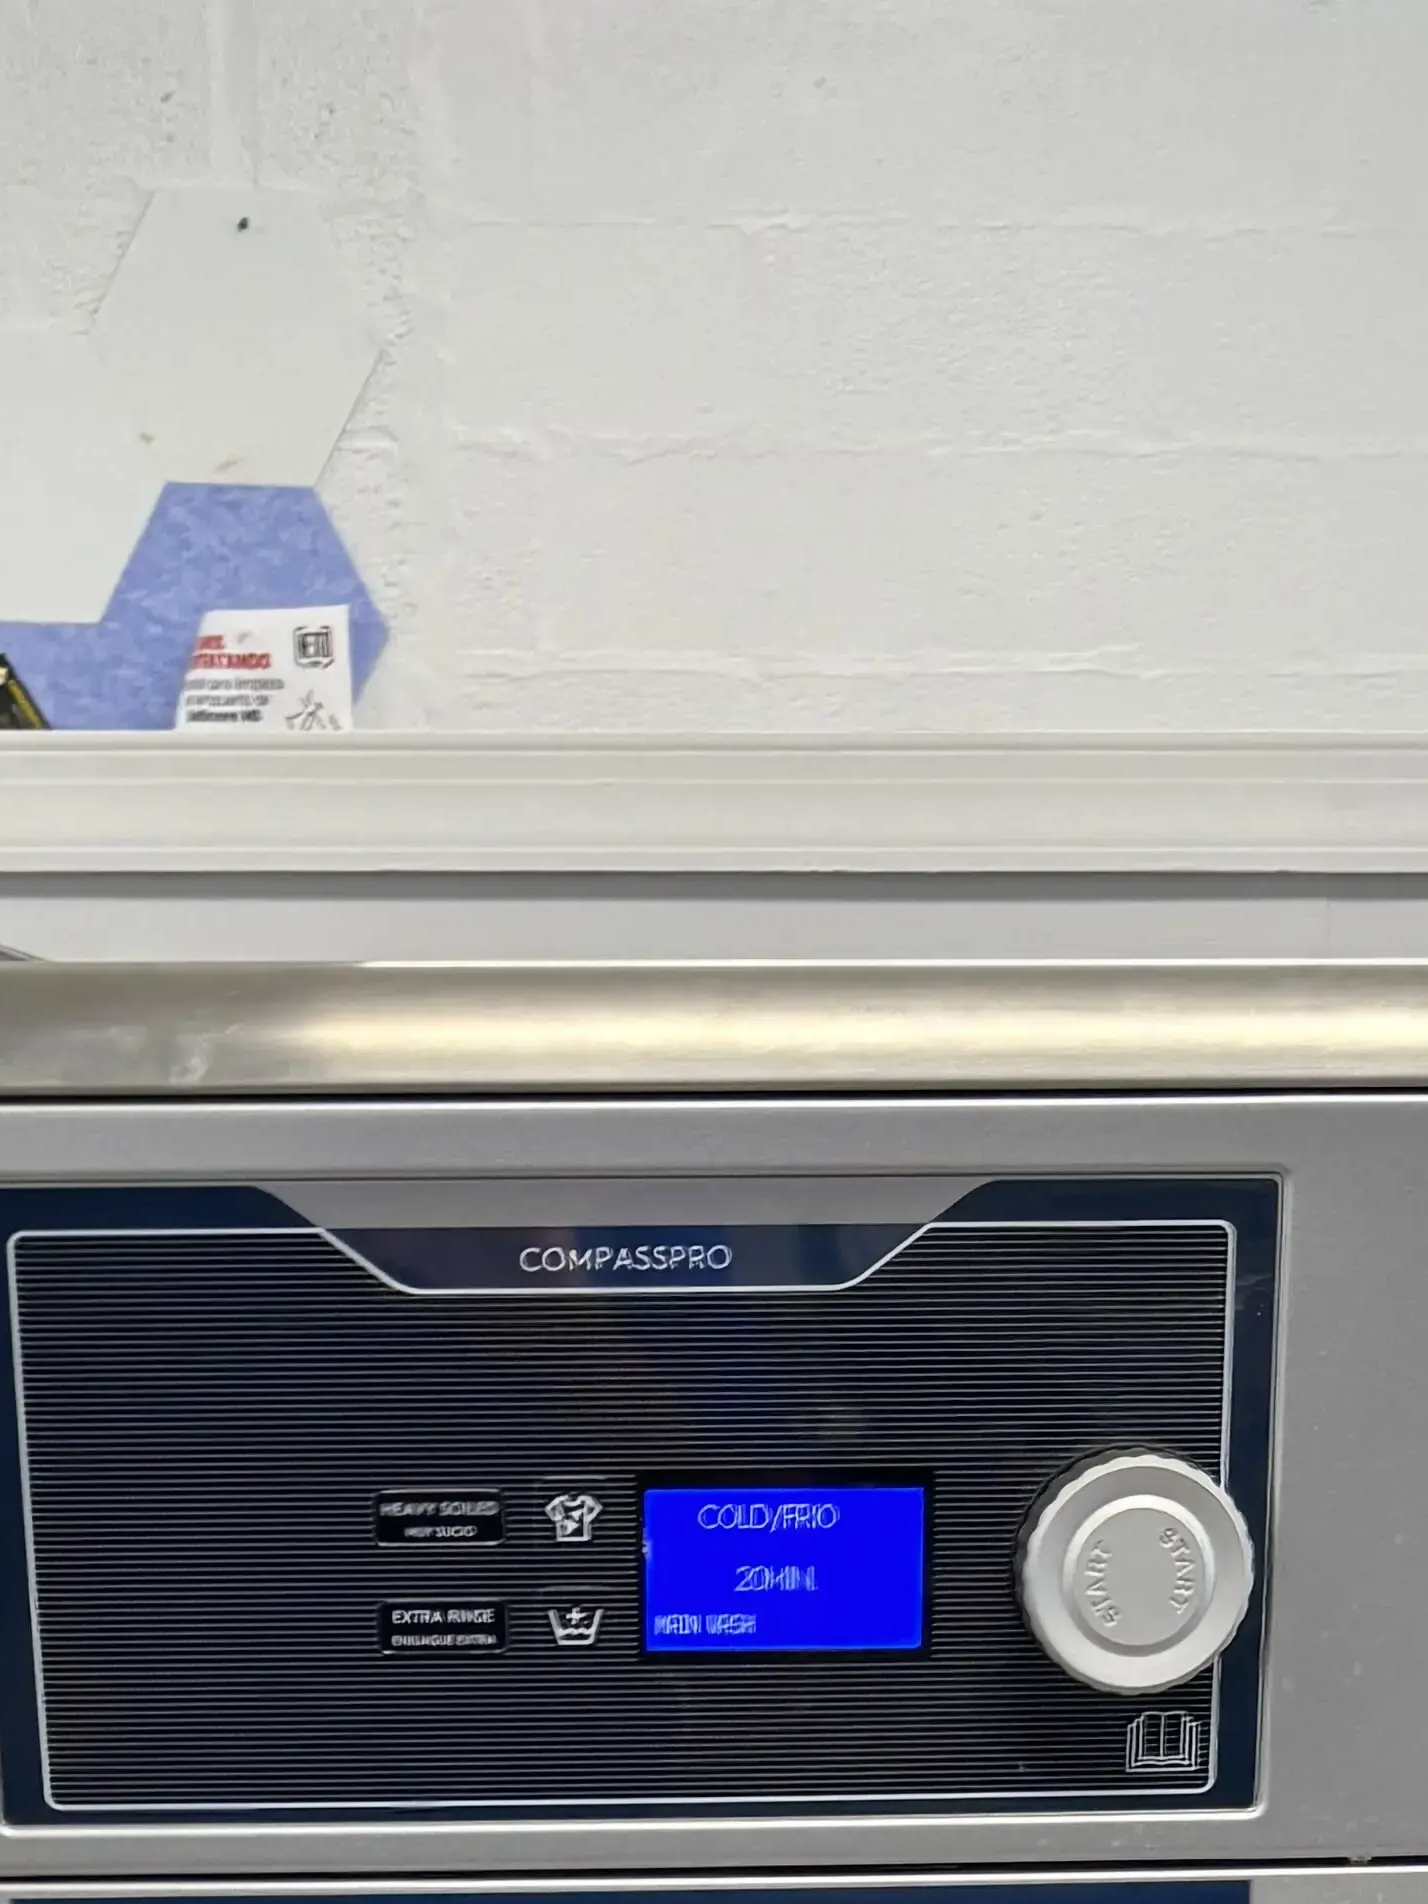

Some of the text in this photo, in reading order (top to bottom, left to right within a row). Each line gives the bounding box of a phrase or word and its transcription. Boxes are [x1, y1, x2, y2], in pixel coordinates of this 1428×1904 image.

[519, 1244, 733, 1272] COMPASSPRO
[379, 1501, 500, 1516] HEAVY SOILED
[697, 1503, 840, 1533] COLD/FRIO
[435, 1525, 478, 1538] SUCIO
[1083, 1539, 1122, 1627] START
[1159, 1527, 1196, 1615] START
[391, 1609, 443, 1624] EXTRA
